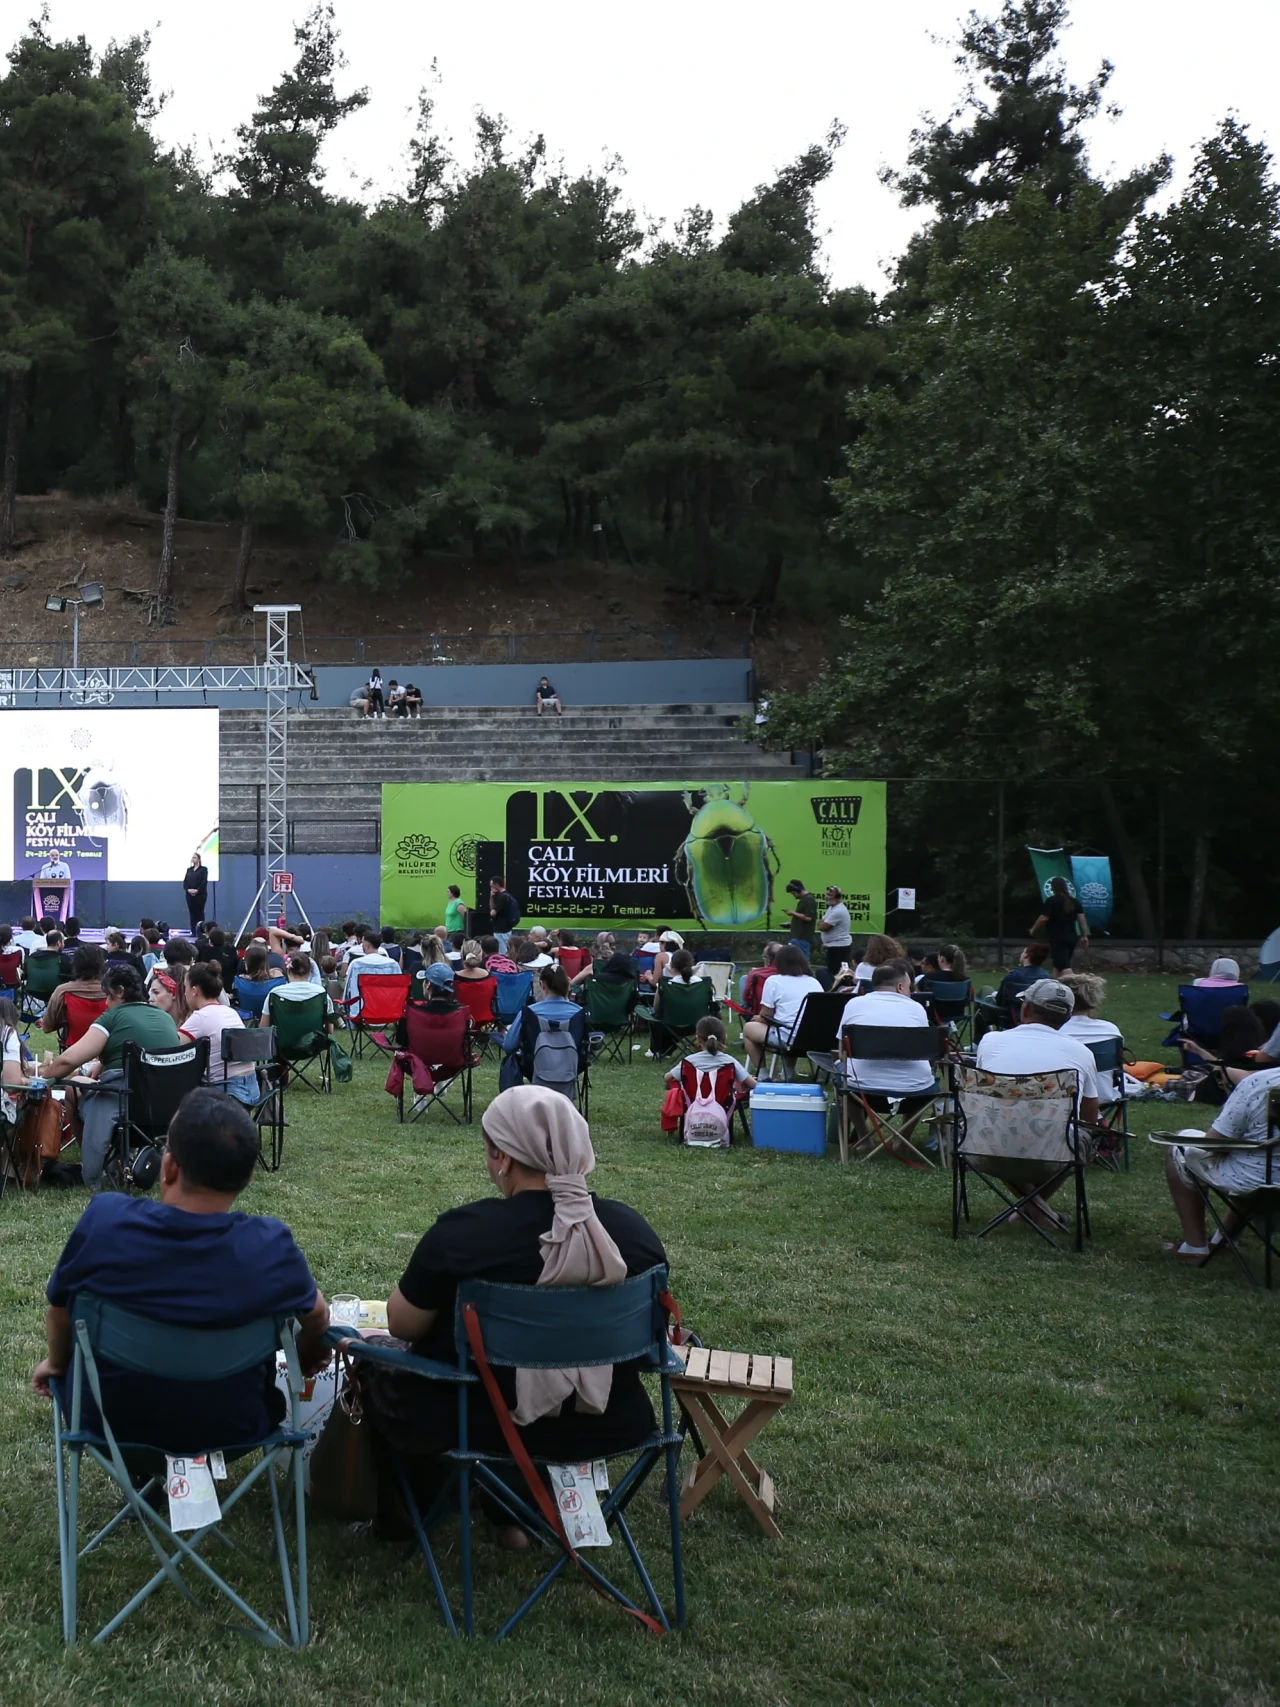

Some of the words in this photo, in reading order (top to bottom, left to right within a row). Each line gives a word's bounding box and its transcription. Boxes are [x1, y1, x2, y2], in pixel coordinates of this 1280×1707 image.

[25, 812, 57, 826] ÇALI
[530, 789, 619, 842] IX.
[25, 823, 55, 837] KÖY
[57, 823, 89, 837] FİLM
[25, 850, 73, 858] 24-25--27
[528, 846, 575, 865] ÇALI
[528, 863, 573, 883] KÖY
[576, 863, 669, 884] FİLMLERİ
[526, 903, 605, 914] 24-25-26-27
[612, 904, 656, 915] Temmuz
